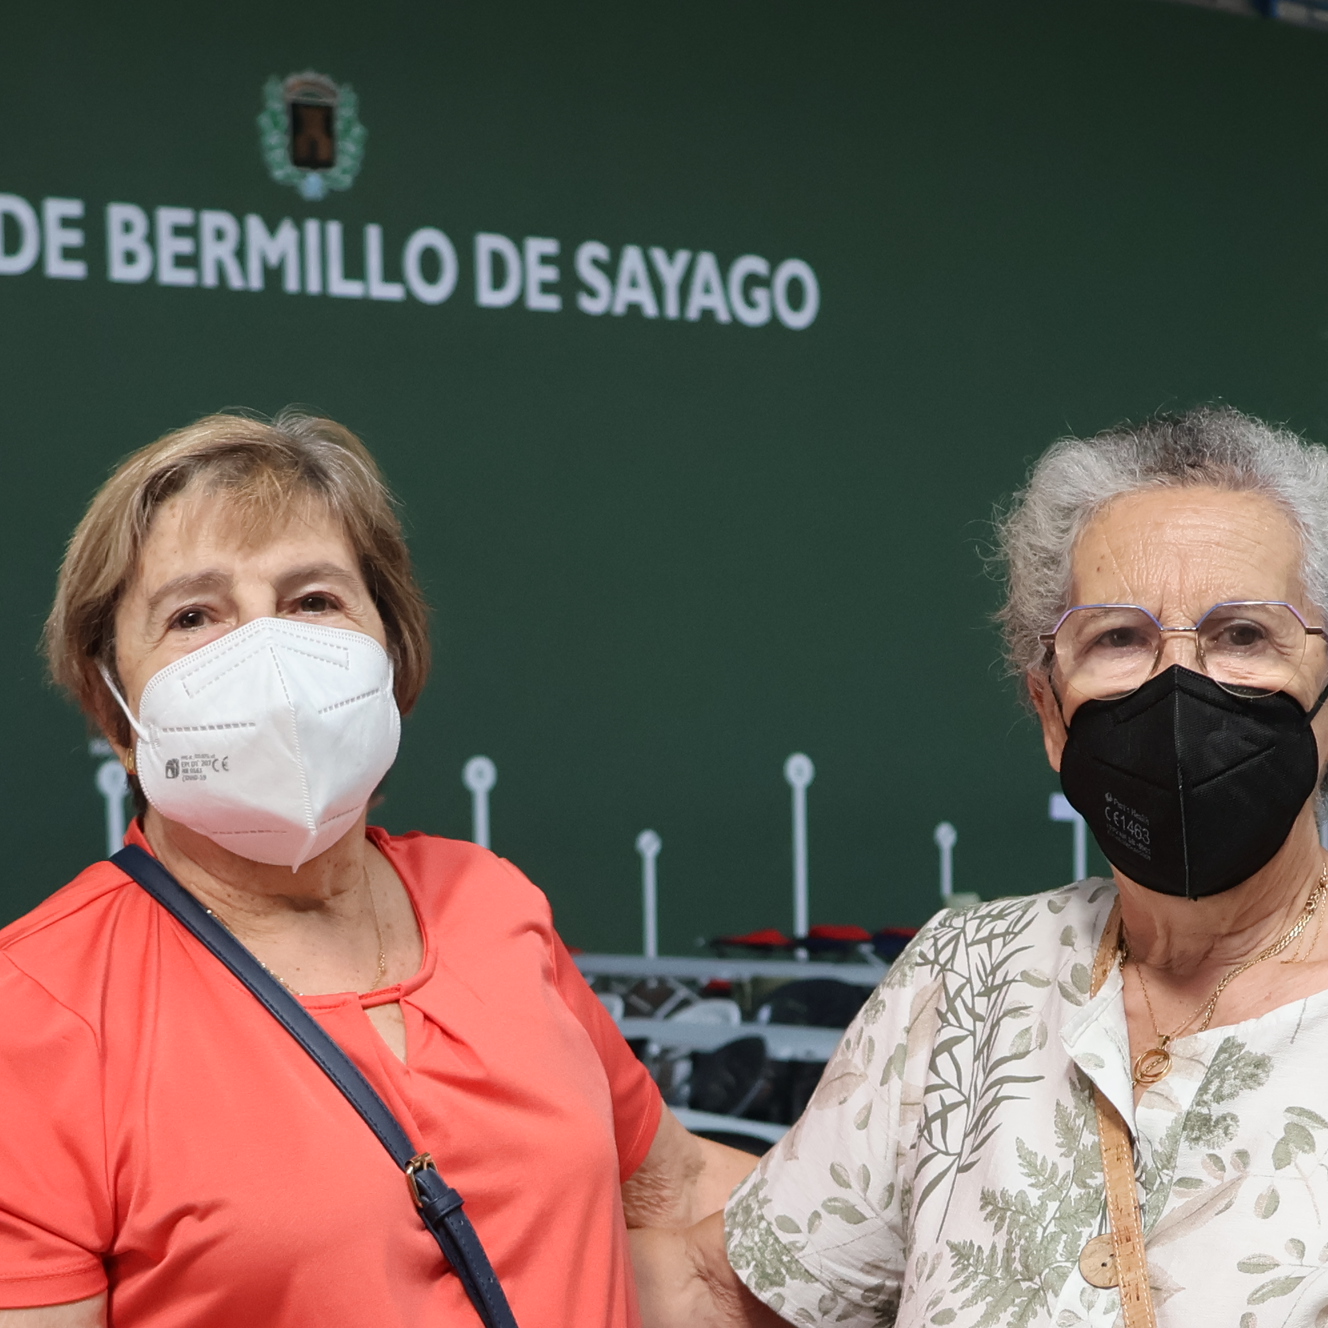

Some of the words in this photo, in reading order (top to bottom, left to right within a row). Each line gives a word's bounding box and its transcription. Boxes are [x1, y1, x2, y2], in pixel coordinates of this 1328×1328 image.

[105, 201, 460, 306] BERMILLO
[473, 231, 563, 313] DE
[573, 240, 821, 331] SAYAGO
